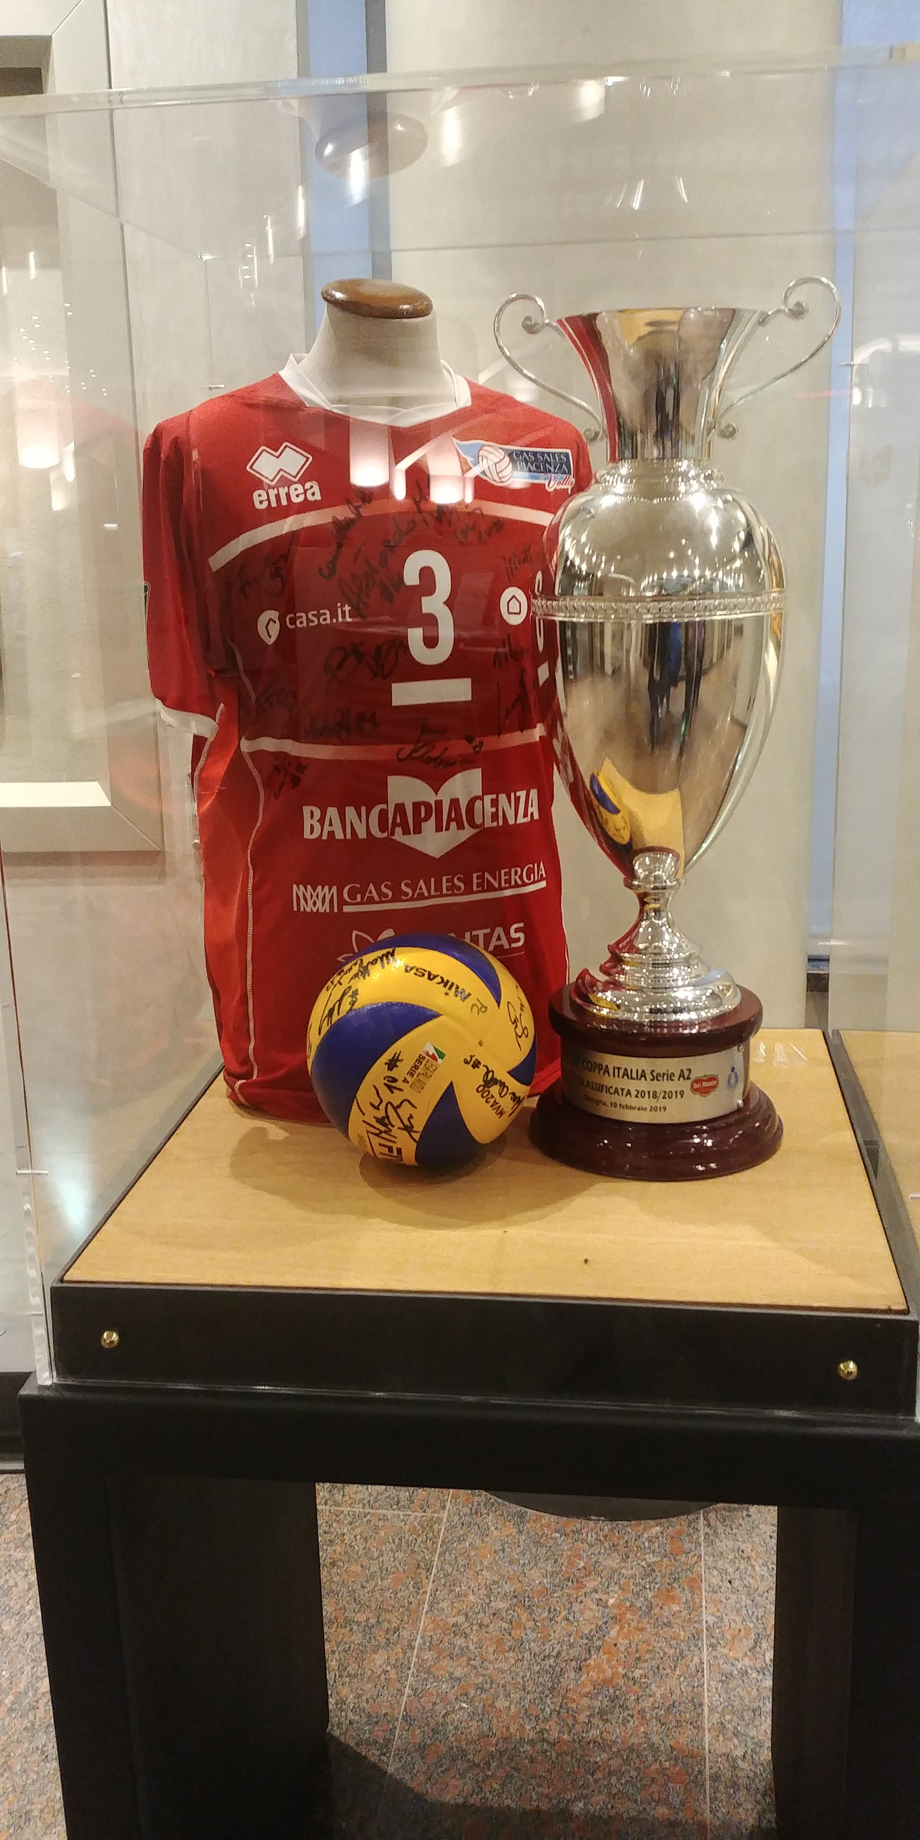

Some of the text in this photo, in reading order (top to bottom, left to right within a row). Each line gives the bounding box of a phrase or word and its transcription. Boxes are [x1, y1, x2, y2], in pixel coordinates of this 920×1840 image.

[513, 450, 567, 462] GAS SALES
[517, 460, 569, 473] PIACENZA
[285, 602, 353, 629] casa.it
[403, 549, 455, 666] 3
[302, 788, 540, 841] BANCAPIACENZA
[342, 860, 547, 903] GAS SALES ENERGIA
[404, 963, 472, 1002] MIKASA
[406, 1053, 426, 1078] SERIE
[582, 1059, 611, 1078] COPPA
[612, 1065, 648, 1082] ITALIA
[650, 1068, 676, 1082] Serie
[677, 1067, 692, 1081] A2
[401, 1076, 410, 1085] A
[476, 1084, 506, 1118] MVA200
[610, 1101, 618, 1109] 10
[619, 1103, 648, 1112] febbraio
[648, 1105, 667, 1113] 2019
[634, 1088, 685, 1102] 2018/2019
